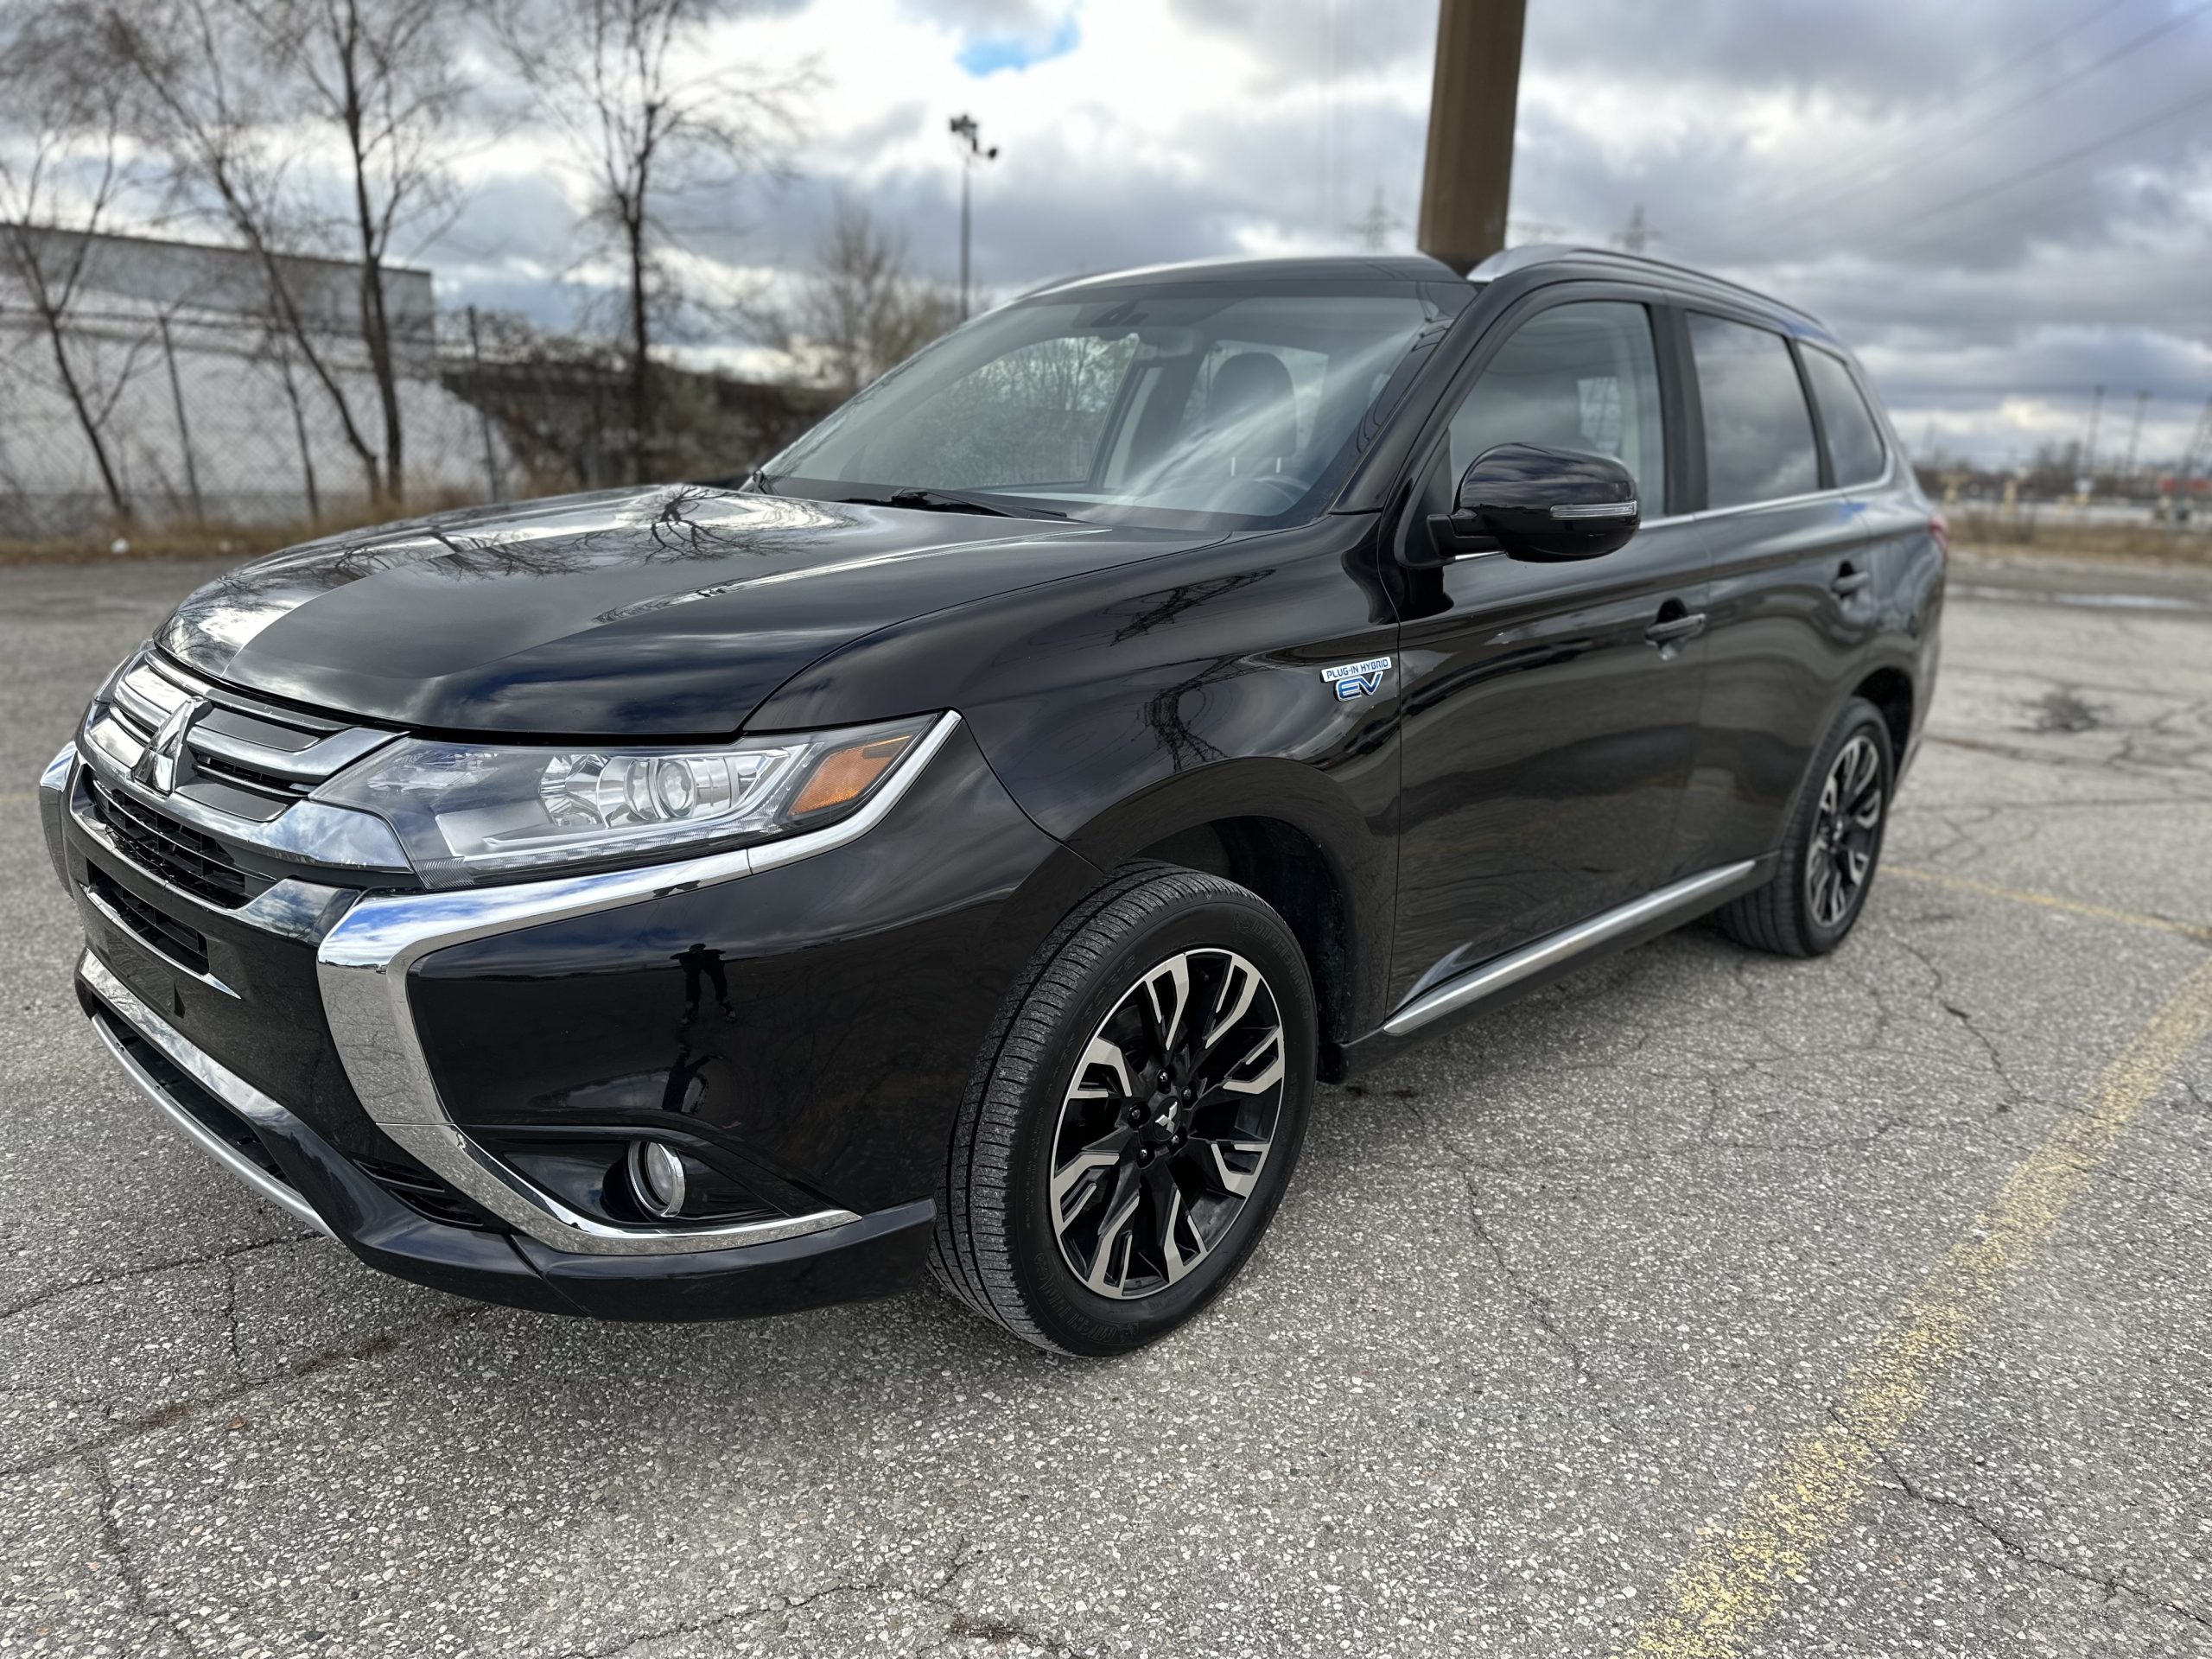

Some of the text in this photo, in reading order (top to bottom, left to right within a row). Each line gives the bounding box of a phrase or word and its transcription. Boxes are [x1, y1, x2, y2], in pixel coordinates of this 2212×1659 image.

[1326, 658, 1389, 680] PLUG-IN HYBRID
[1336, 671, 1383, 702] EV
